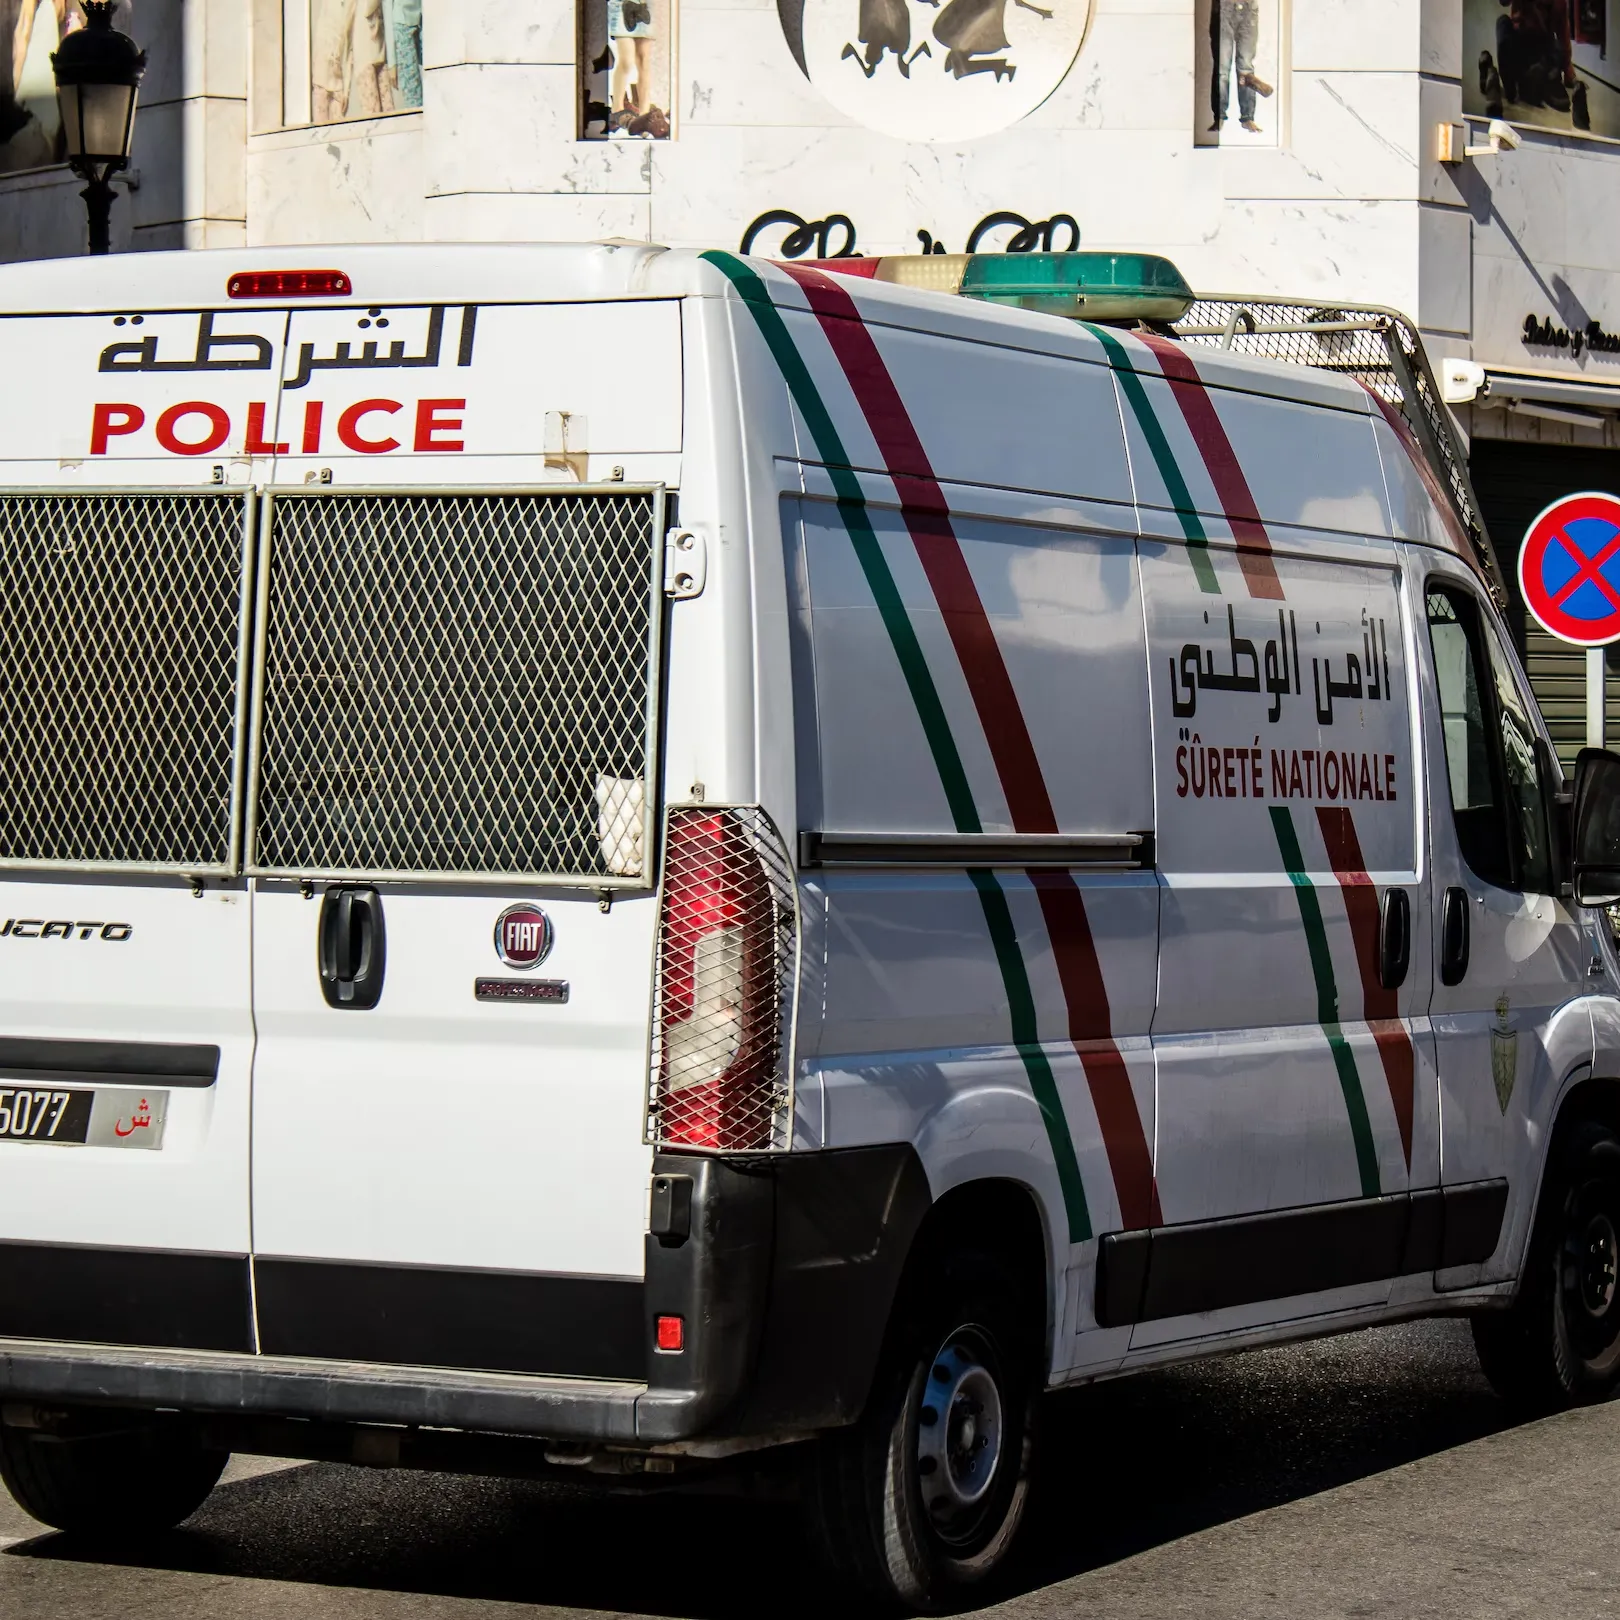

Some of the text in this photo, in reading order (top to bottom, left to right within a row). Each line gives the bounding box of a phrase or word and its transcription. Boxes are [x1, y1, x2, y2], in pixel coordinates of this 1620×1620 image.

[98, 305, 478, 390] الشرطة
[90, 398, 467, 456] POLICE
[1176, 733, 1397, 801] SÛRETÉ NATIONALE
[506, 922, 542, 952] FIAT
[114, 1098, 152, 1137] ش
